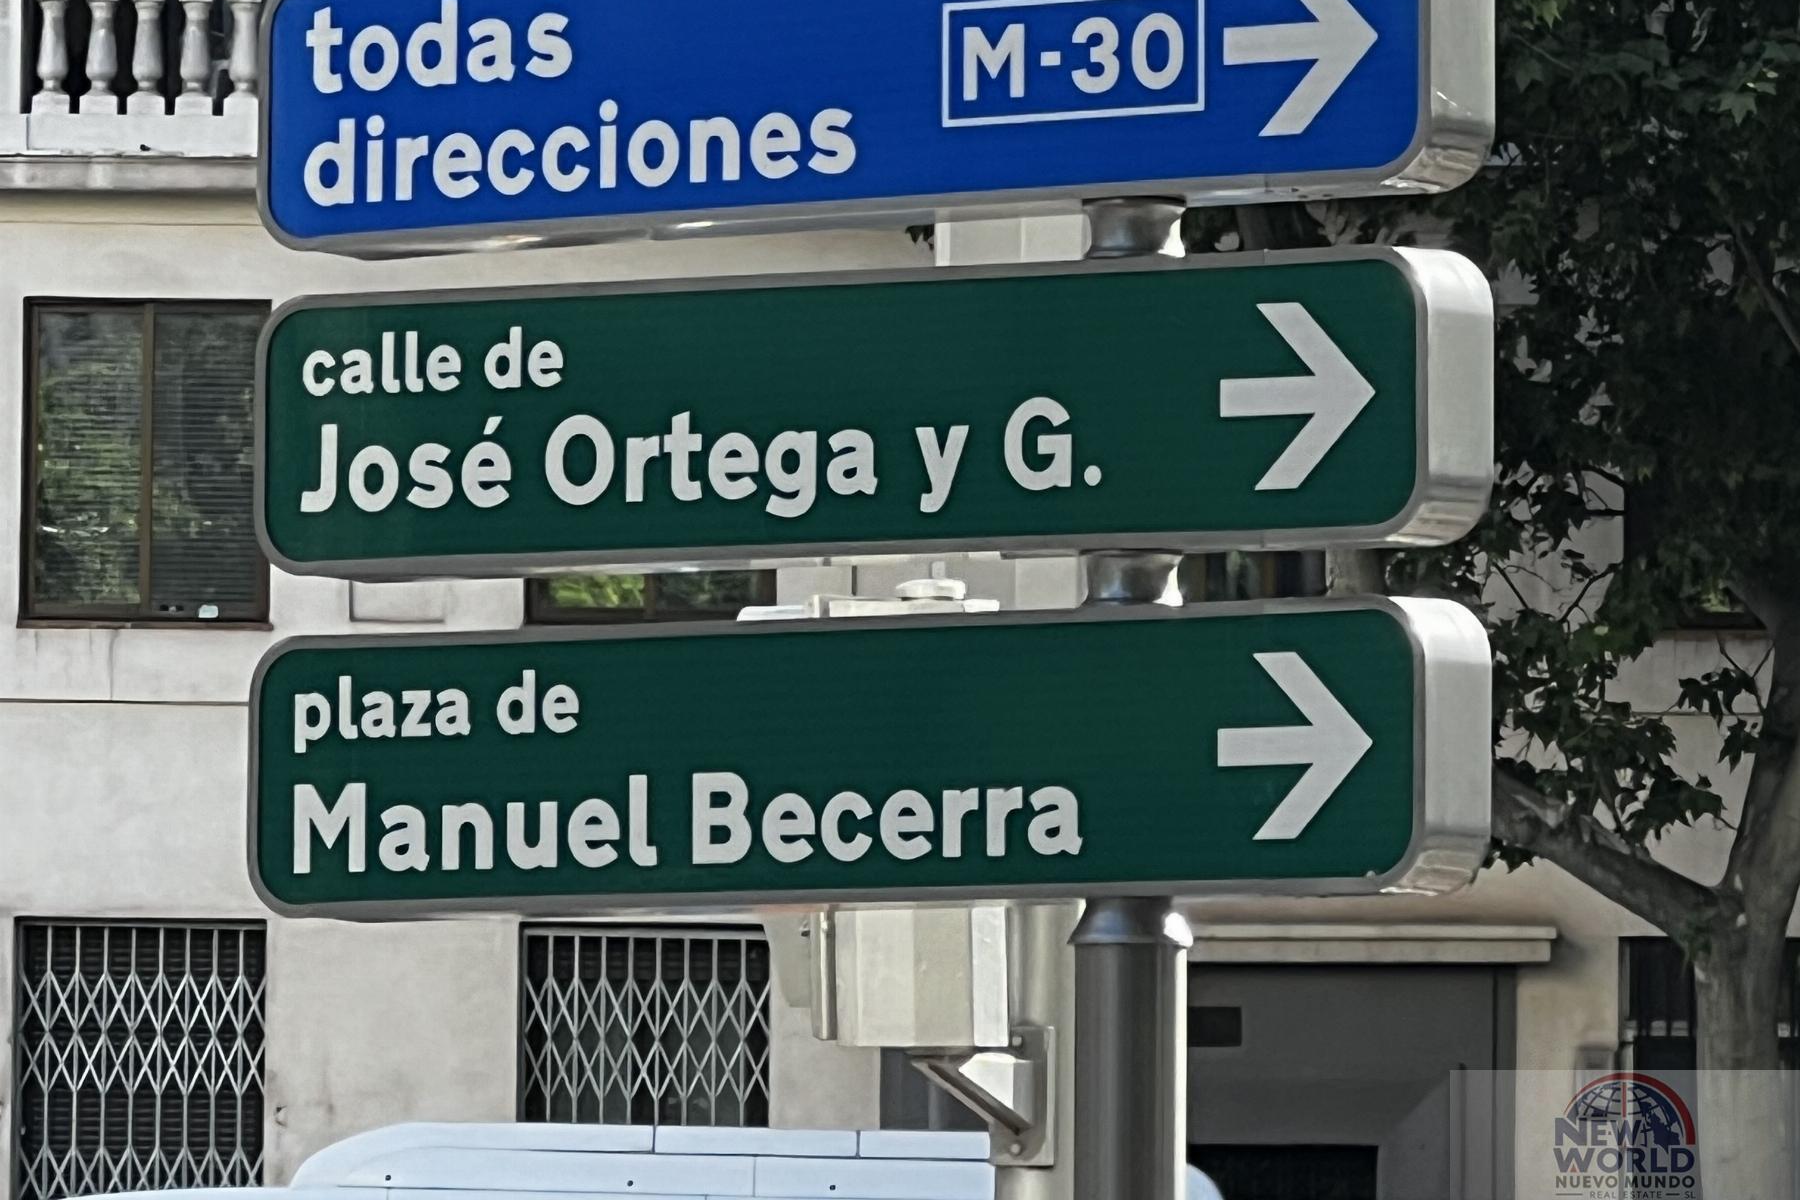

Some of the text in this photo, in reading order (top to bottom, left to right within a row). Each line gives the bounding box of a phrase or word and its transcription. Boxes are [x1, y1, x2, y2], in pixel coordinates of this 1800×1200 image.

[962, 11, 1185, 102] M-30
[302, 98, 857, 208] direcciones
[301, 325, 565, 398] calle de
[299, 395, 1103, 519] José Ortega y G.
[293, 668, 580, 755] plaza de
[292, 770, 1084, 875] Manuel Becerra
